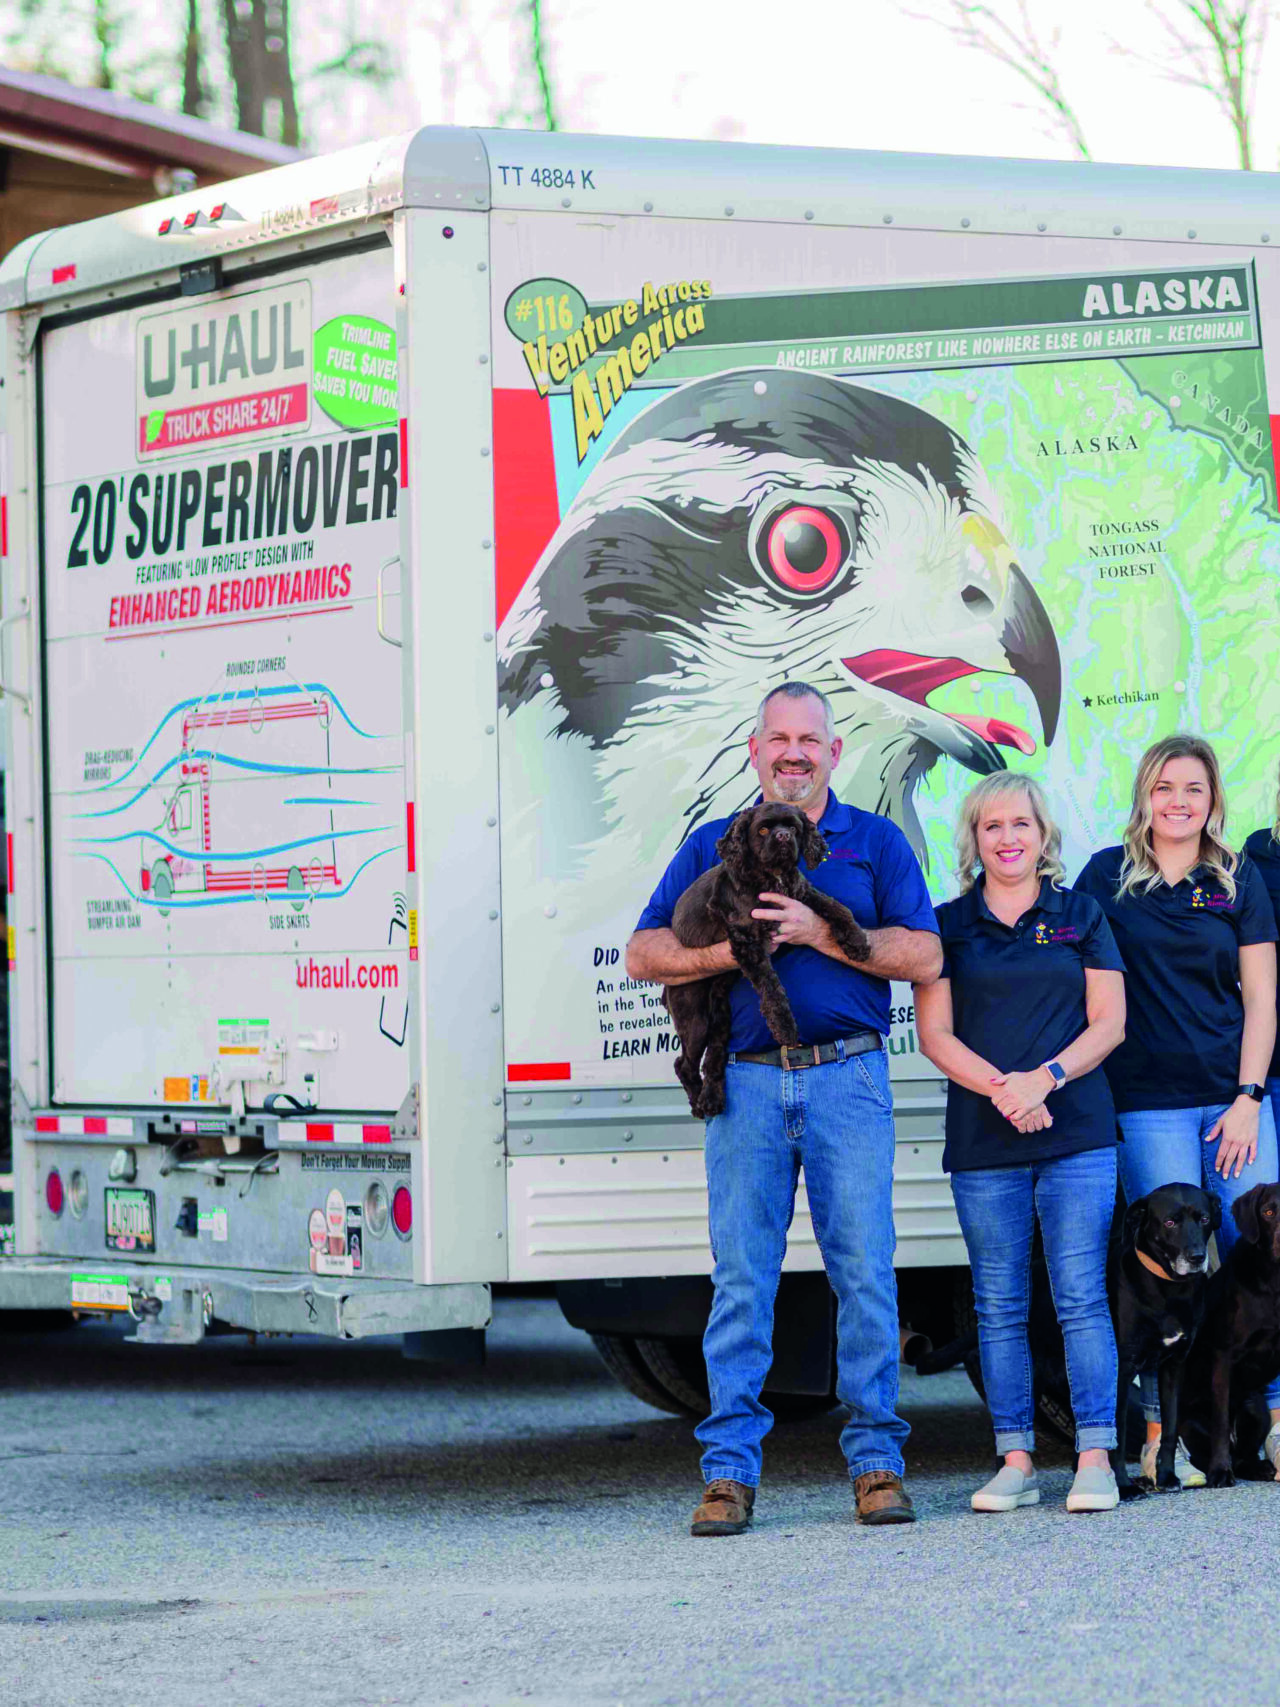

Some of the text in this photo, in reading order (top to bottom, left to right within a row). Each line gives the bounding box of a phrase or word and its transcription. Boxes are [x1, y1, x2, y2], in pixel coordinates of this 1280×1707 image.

[498, 166, 595, 189] TT 4884 K
[1083, 276, 1242, 318] ALASKA
[514, 294, 573, 332] #116
[144, 300, 304, 398] U-HAUL
[342, 322, 391, 351] TRIMLINE
[522, 280, 713, 399] Venture Across
[776, 347, 838, 367] ANCIENT
[843, 341, 933, 363] RAINFOREST
[937, 339, 967, 358] LIKE
[973, 332, 1040, 357] NOWHERE
[1045, 332, 1078, 350] ELSE
[1083, 330, 1102, 348] ON
[1107, 326, 1151, 346] EARTH
[1168, 320, 1244, 343] KETCHIKAN
[326, 347, 357, 372] FUEL
[314, 371, 398, 409] SAVES YOU MON
[571, 303, 706, 467] America
[167, 394, 292, 442] TRUCK SHARE 24/7
[1171, 370, 1264, 449] CANADA
[1036, 434, 1139, 457] ALASKA
[126, 432, 398, 560] SUPERMOVER
[1089, 519, 1160, 537] TONGASS
[136, 561, 183, 584] FEATURING
[255, 544, 288, 567] DESIGN
[290, 540, 313, 562] WITH
[1088, 541, 1166, 559] NATIONAL
[1099, 563, 1157, 579] FOREST
[109, 563, 352, 629] ENHANCED AERODYNAMICS
[257, 657, 286, 674] CORNERS
[1097, 689, 1160, 706] Ketchikan
[269, 915, 284, 930] SIDE
[594, 947, 619, 967] DID
[296, 957, 399, 988] uhaul.com
[596, 976, 661, 995] An elusiv
[598, 993, 662, 1013] in the Ton
[600, 1012, 670, 1033] be revealed
[603, 1037, 651, 1060] LEARN
[656, 1032, 681, 1052] MO
[301, 1152, 411, 1172] Don't Forget Your Moving Suppli
